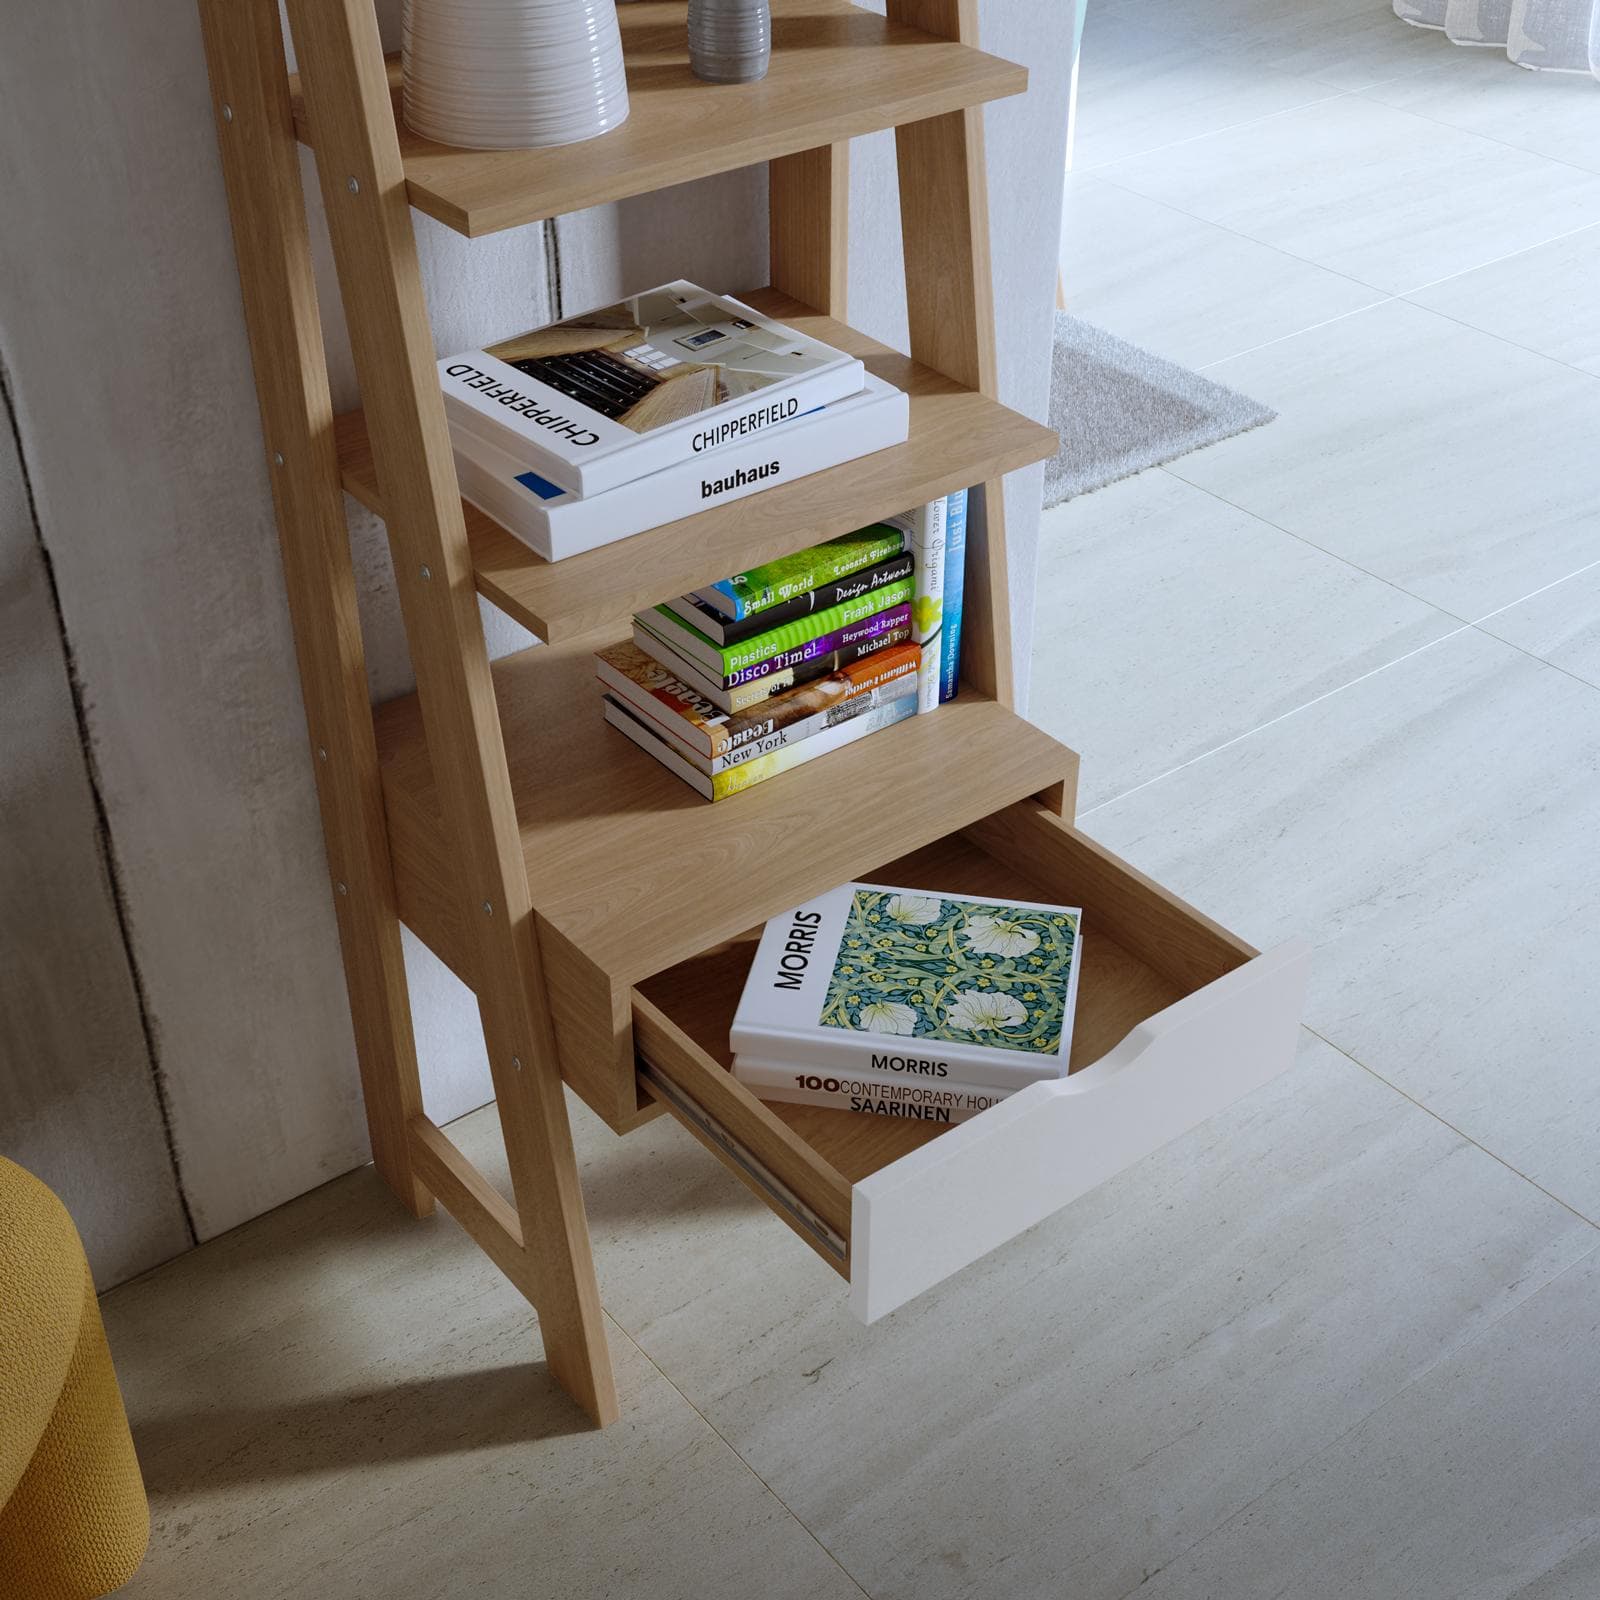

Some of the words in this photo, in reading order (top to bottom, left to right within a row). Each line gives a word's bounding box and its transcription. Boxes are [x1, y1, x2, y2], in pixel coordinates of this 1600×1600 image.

[445, 363, 600, 447] CHIPPERFIELD
[692, 397, 798, 452] CHIPPERFIELD
[700, 460, 780, 499] bauhaus
[833, 554, 867, 576] Leonard
[836, 583, 868, 602] Design
[870, 561, 912, 589] Artwork
[744, 591, 775, 615] Small
[778, 575, 814, 599] World
[843, 601, 874, 622] Frank
[878, 587, 911, 608] Jason
[842, 621, 879, 643] Heywood
[881, 613, 909, 630] Rapper
[857, 634, 891, 657] Michael
[893, 628, 910, 641] Top
[730, 643, 777, 670] Plastics
[727, 663, 770, 687] Disco
[721, 748, 752, 768] New
[755, 730, 788, 754] York
[773, 910, 822, 991] MORRIS
[871, 1054, 948, 1077] MORRIS
[850, 1097, 950, 1123] SAARINEN
